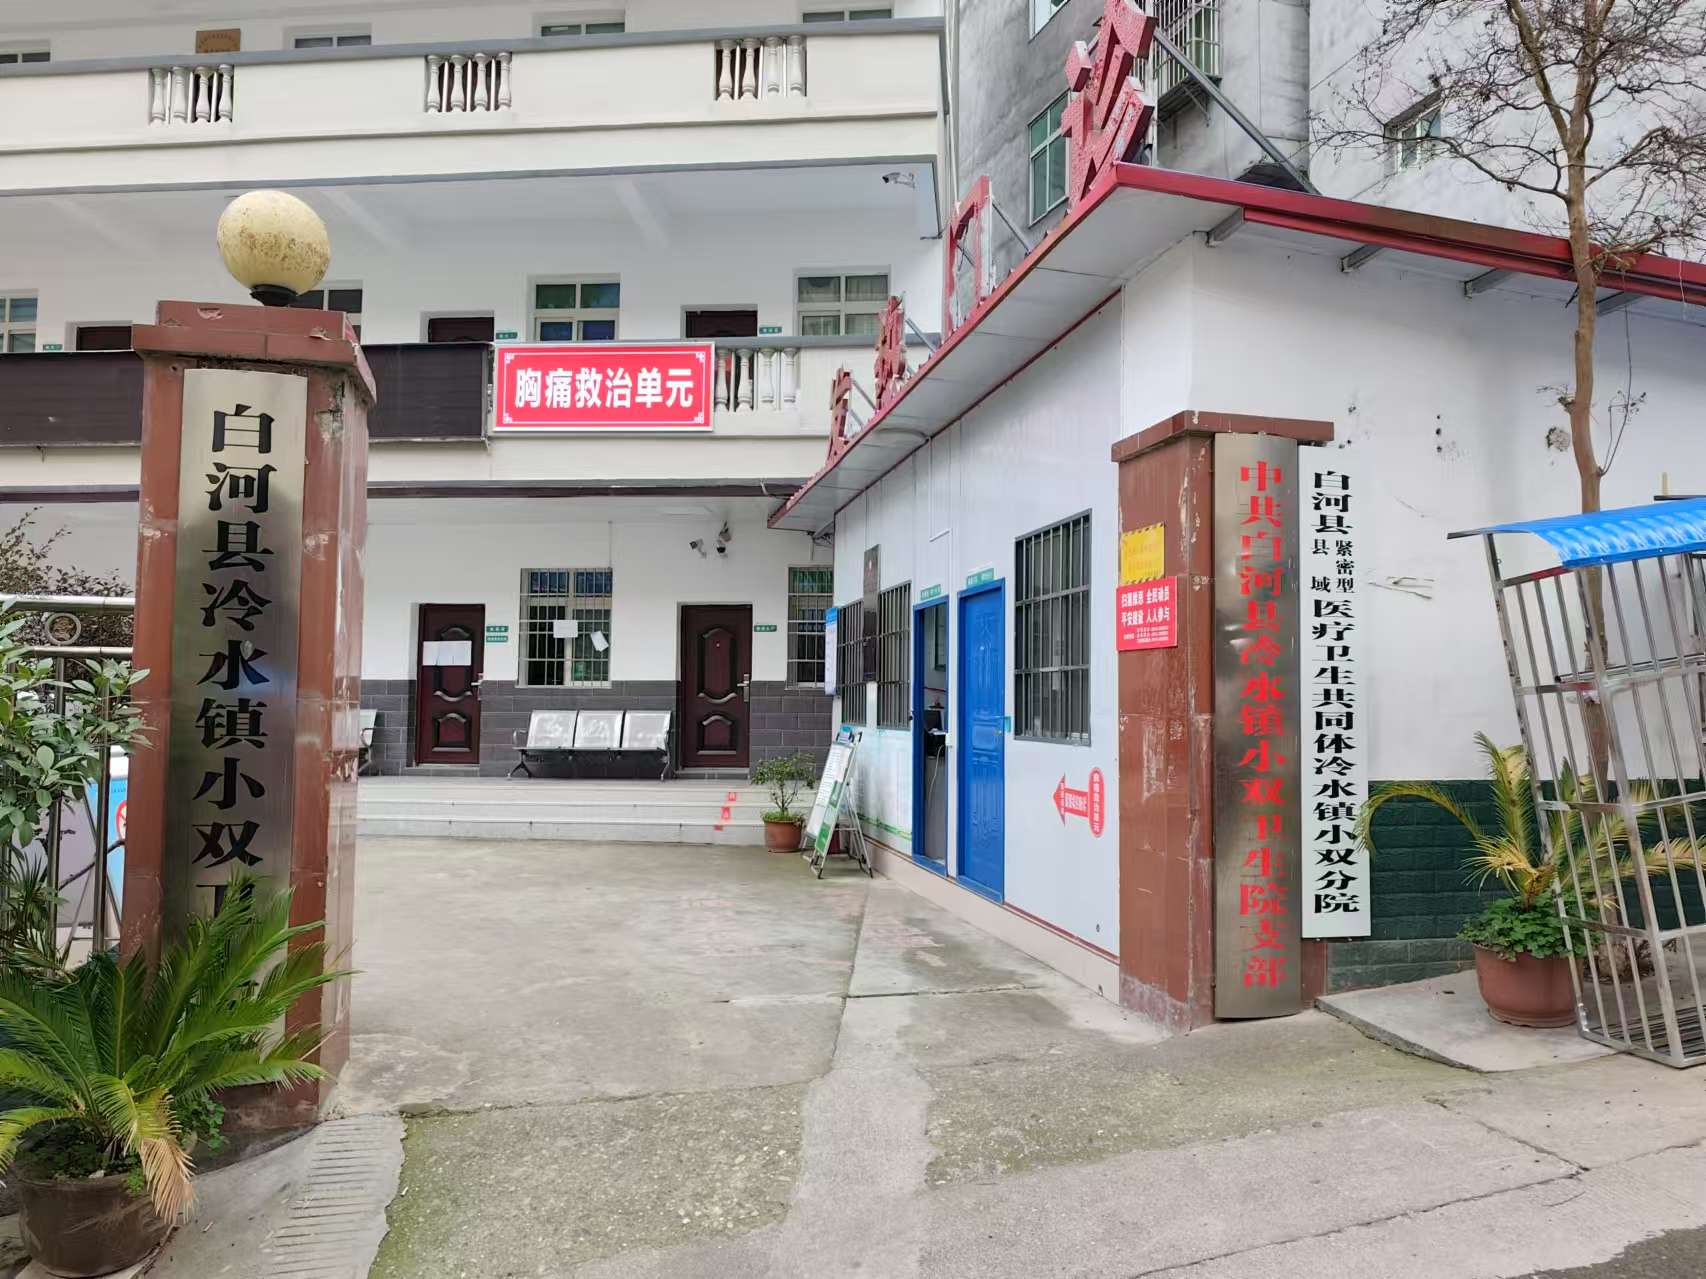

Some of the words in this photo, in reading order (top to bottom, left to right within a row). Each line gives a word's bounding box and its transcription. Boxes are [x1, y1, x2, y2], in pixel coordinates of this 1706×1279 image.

[514, 367, 694, 408] 胸痛救治单元
[1238, 461, 1288, 988] 中共白河县冷水镇小双卫生院支部
[1311, 599, 1360, 914] 医疗卫生共同体冷水镇小双分院
